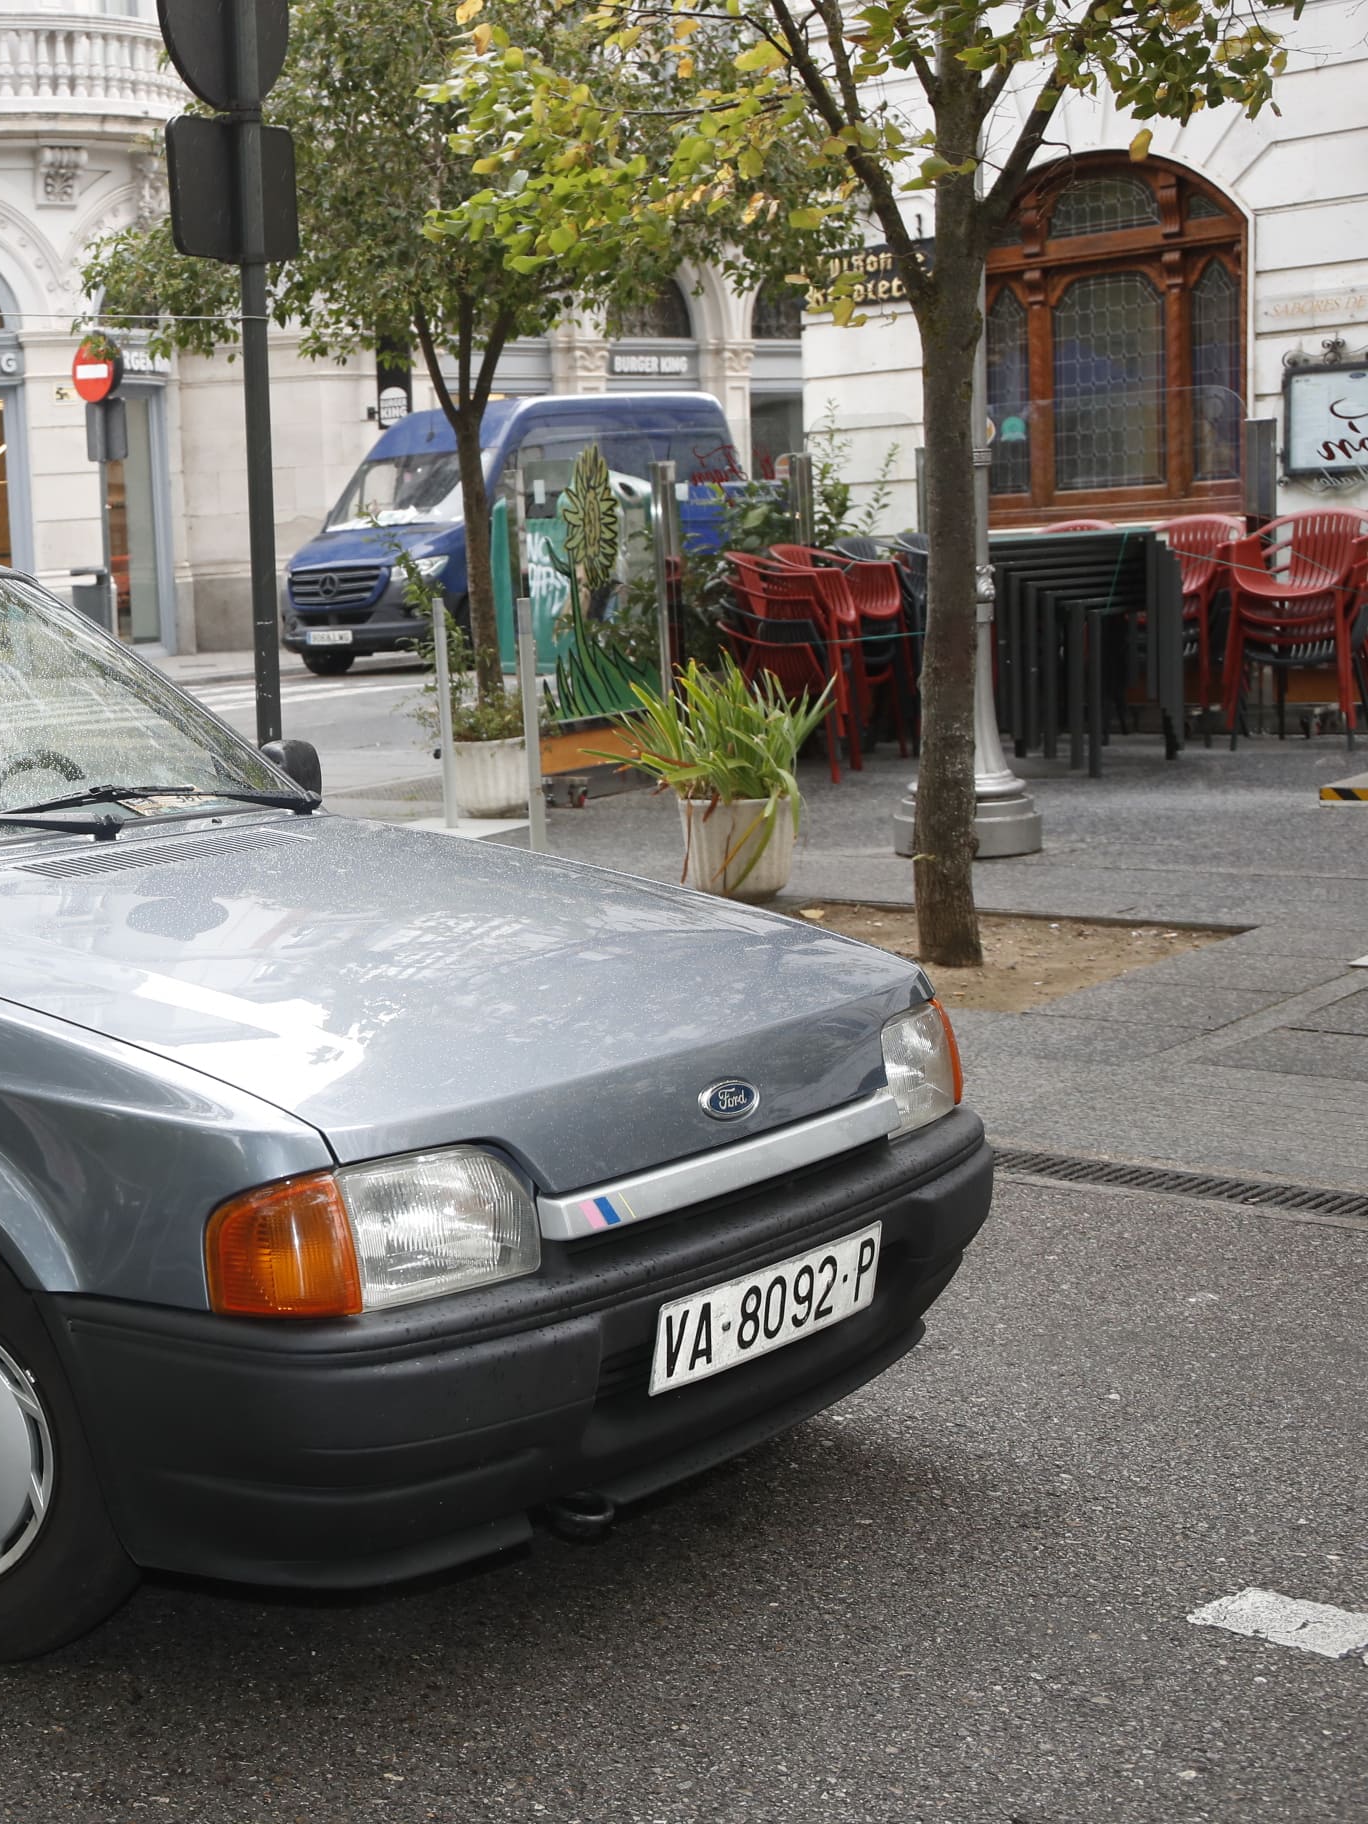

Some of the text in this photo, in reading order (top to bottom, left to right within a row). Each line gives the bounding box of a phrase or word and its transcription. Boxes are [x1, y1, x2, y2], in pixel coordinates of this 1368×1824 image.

[614, 355, 688, 373] BURGER KING
[718, 1087, 748, 1110] Ford
